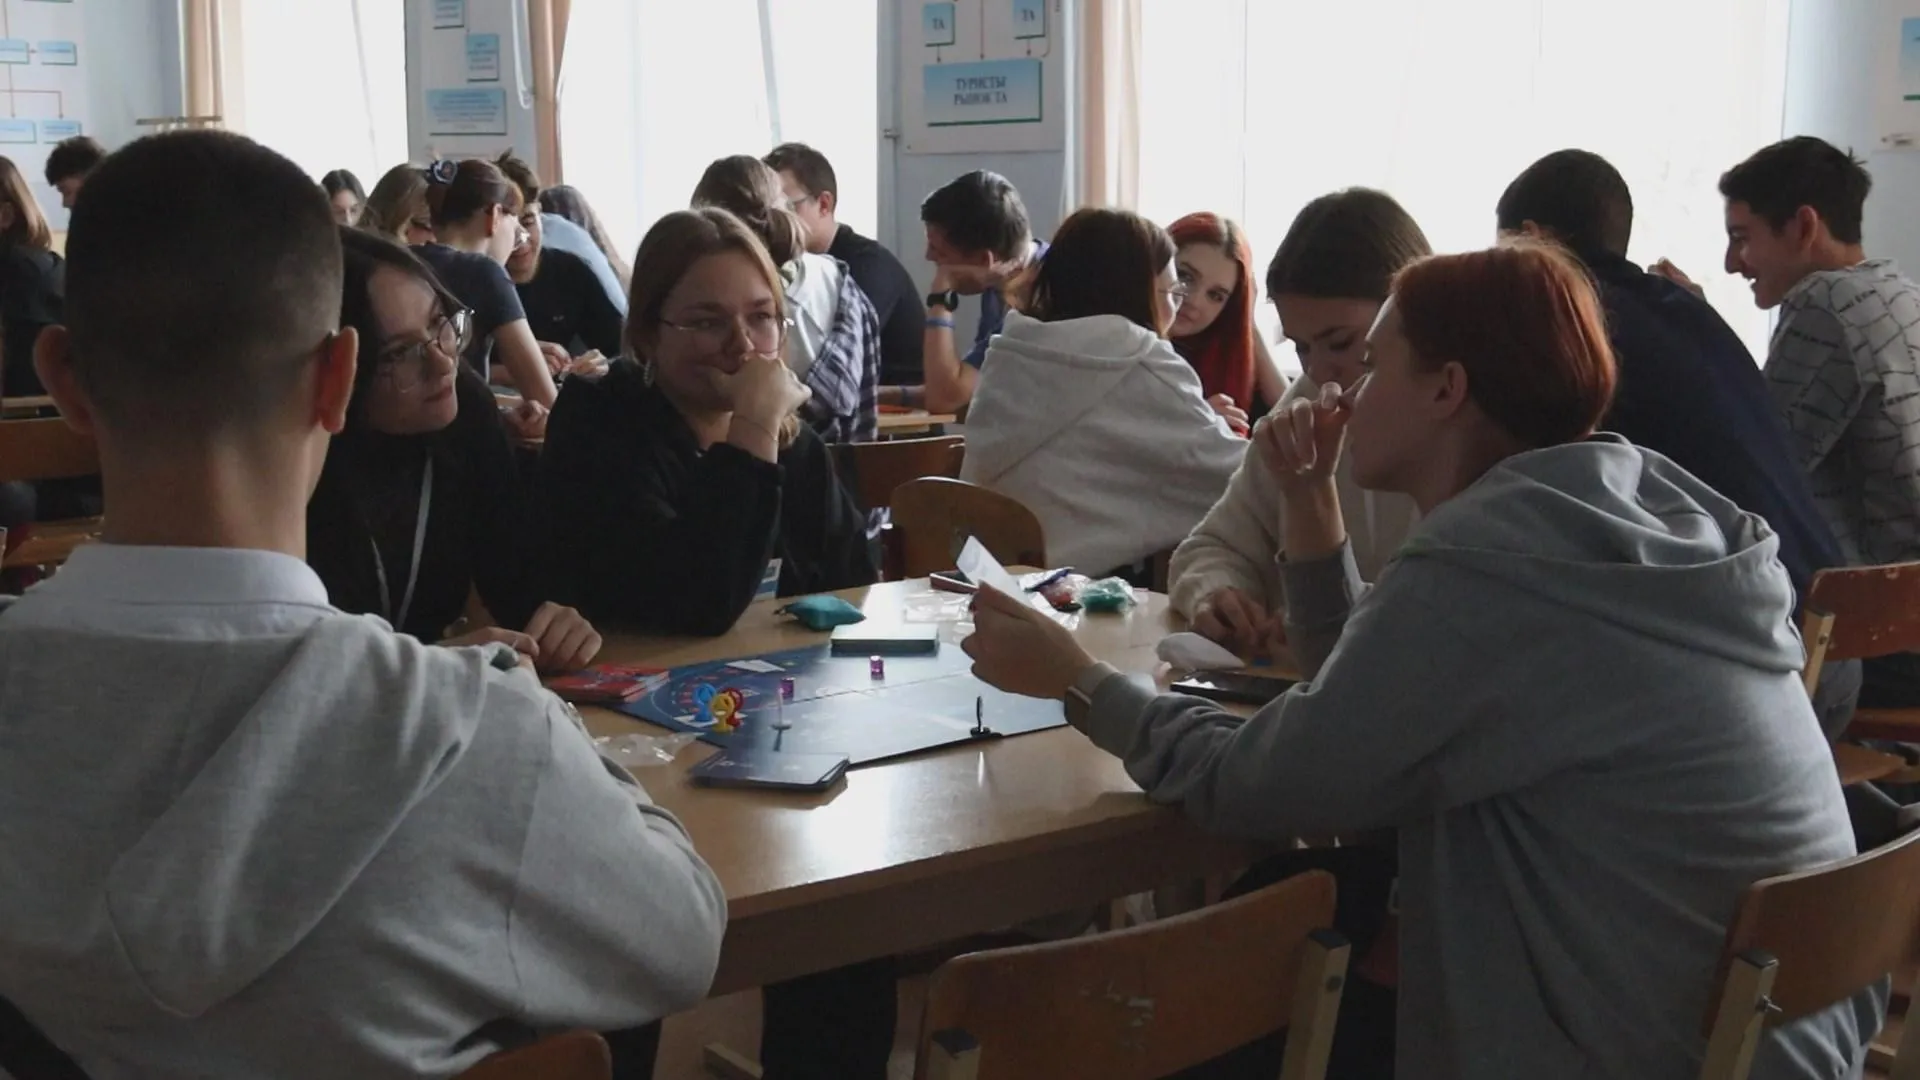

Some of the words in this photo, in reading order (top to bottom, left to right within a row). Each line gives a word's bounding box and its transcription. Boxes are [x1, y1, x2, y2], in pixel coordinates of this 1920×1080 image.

[932, 17, 946, 30] ТА
[956, 76, 1007, 90] ТУРИСТЫ
[995, 91, 1008, 104] ТА
